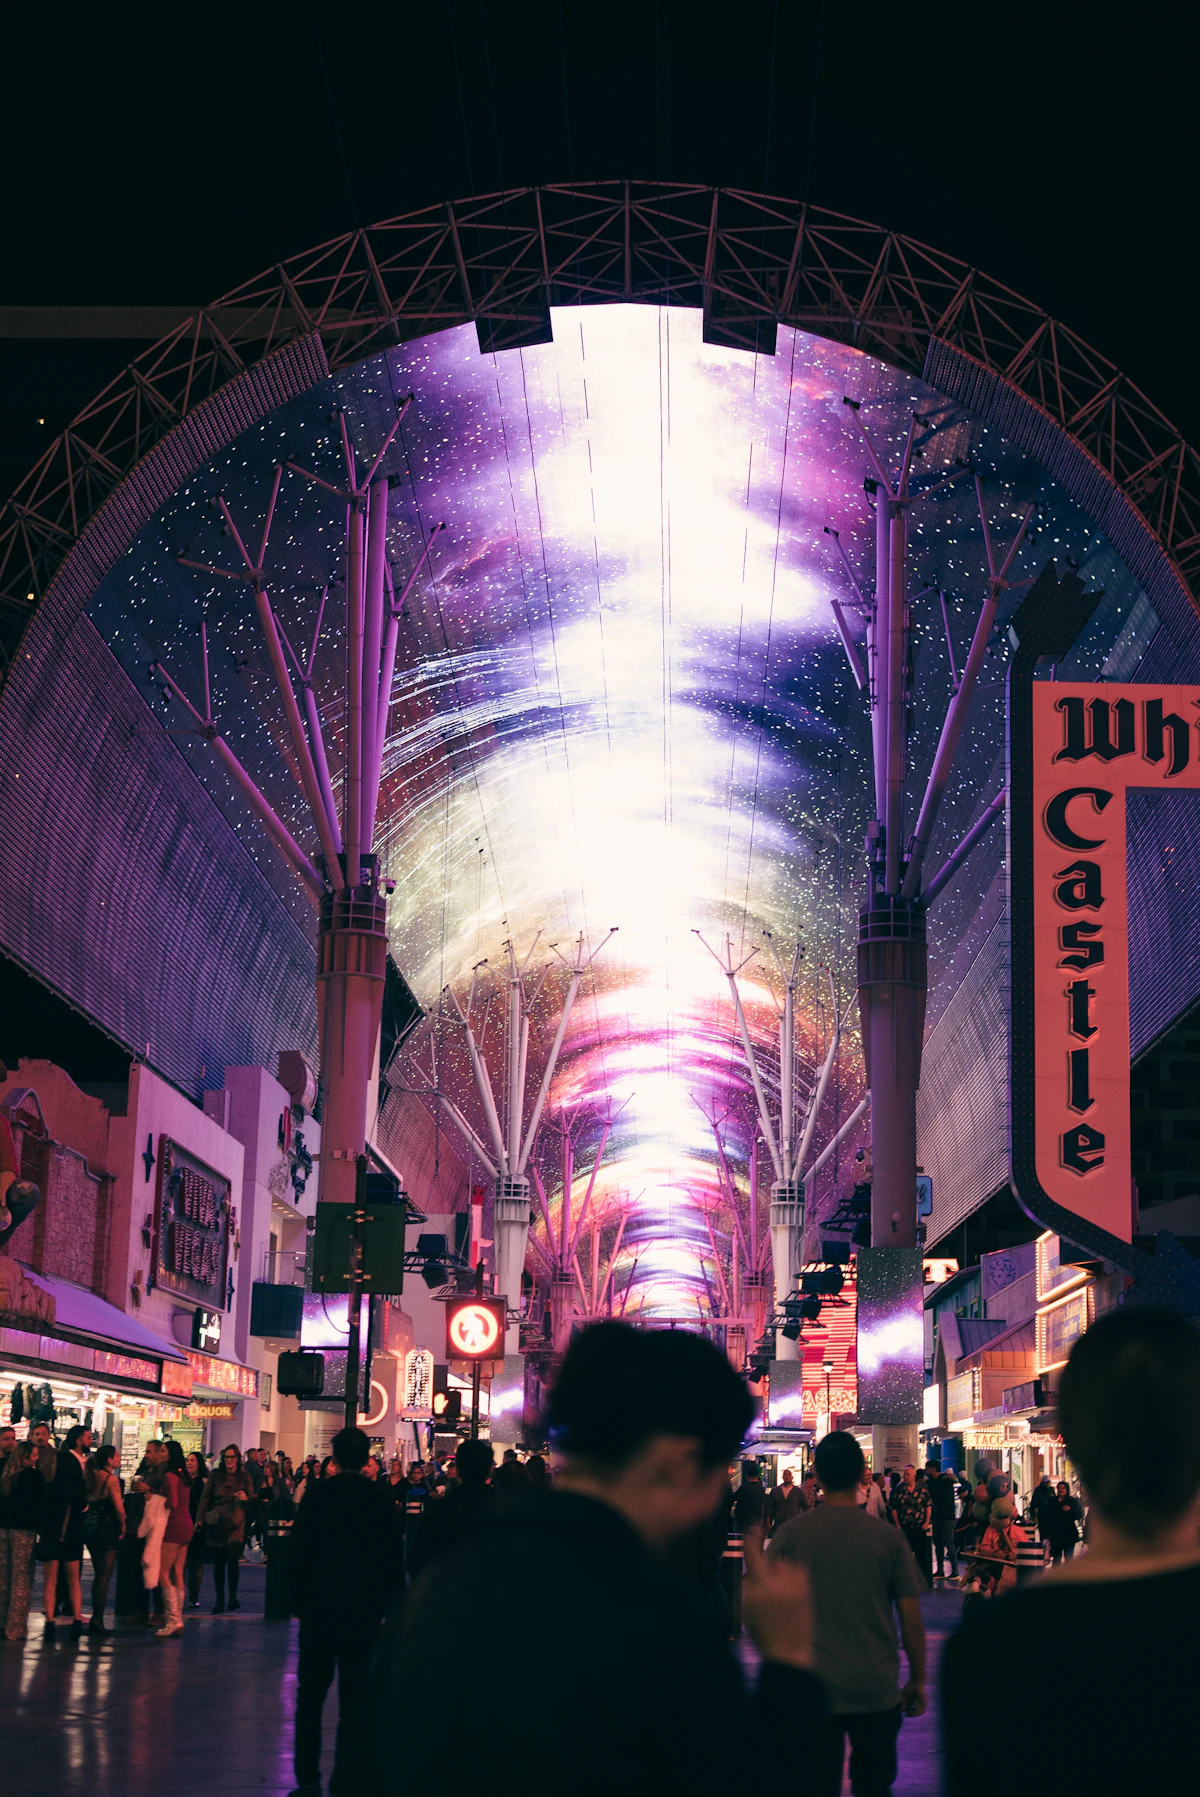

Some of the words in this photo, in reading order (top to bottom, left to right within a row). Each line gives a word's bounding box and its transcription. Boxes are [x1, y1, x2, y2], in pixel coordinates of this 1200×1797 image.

[1042, 787, 1114, 1177] Castle
[173, 1220, 219, 1286] VEGAS
[189, 1406, 232, 1417] LIQUOR
[1006, 1426, 1063, 1442] LIQUO
[177, 1440, 202, 1452] APE
